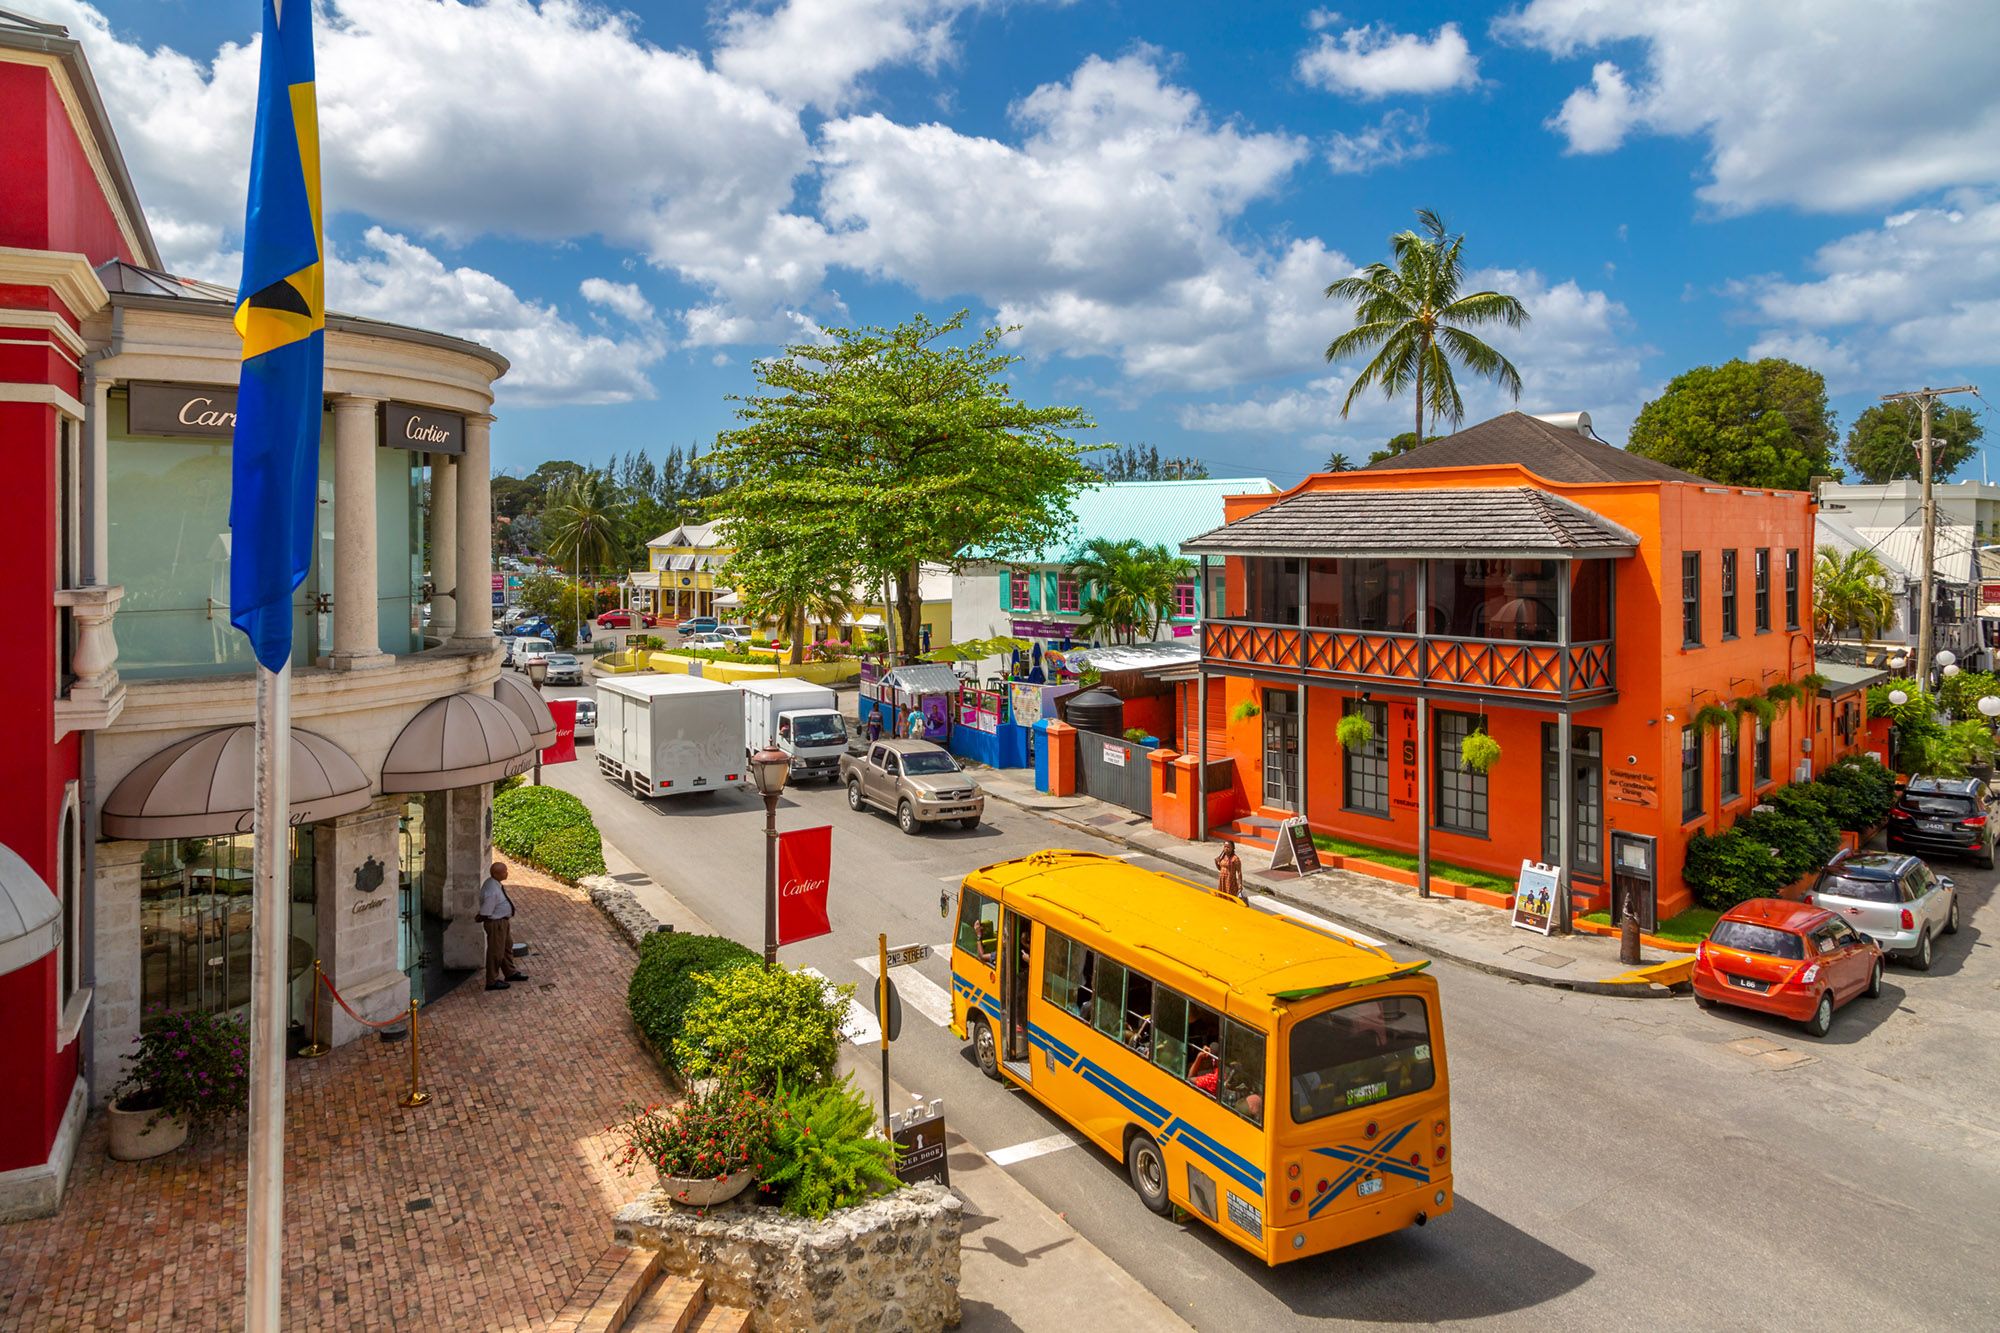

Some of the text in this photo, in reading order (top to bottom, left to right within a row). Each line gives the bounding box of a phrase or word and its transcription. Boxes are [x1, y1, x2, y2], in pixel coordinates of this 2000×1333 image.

[406, 415, 450, 443] Cartier
[503, 758, 532, 779] Cartier
[1610, 769, 1642, 780] Courtyard
[1619, 780, 1657, 792] Conditioned
[1622, 787, 1642, 798] Dining
[782, 879, 825, 897] Cartier
[351, 898, 387, 915] Cartier
[902, 946, 929, 962] STREET
[1740, 979, 1747, 987] L
[920, 1148, 941, 1160] DOOR
